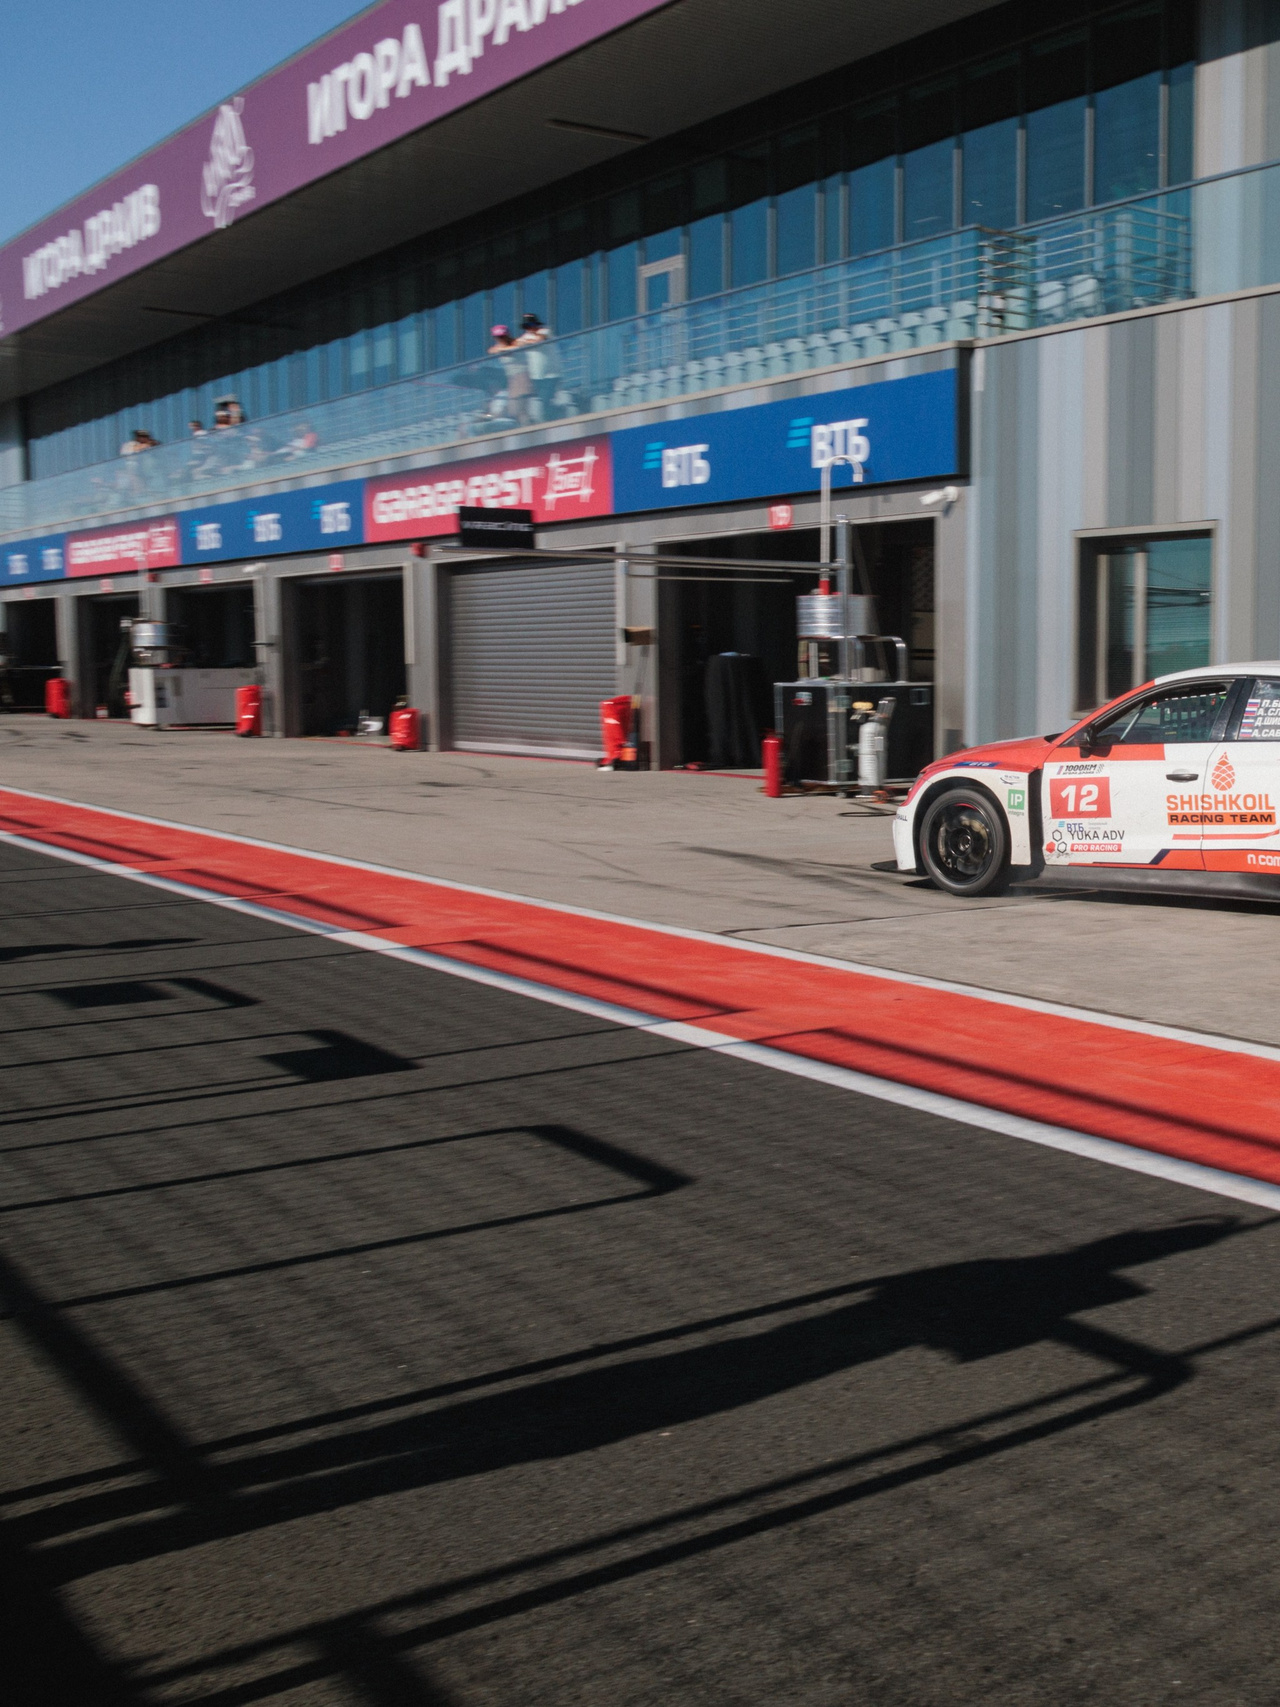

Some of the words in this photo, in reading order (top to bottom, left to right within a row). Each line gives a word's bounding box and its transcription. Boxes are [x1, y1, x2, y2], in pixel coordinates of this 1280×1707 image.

[307, 22, 431, 145] ИГОРА
[434, 0, 586, 87] ДРА
[811, 417, 870, 468] ВТБ
[661, 443, 711, 488] ВТБ
[1010, 793, 1023, 806] IP
[1060, 784, 1099, 812] 12
[1166, 793, 1276, 811] SHISHKOIL
[1170, 814, 1224, 823] RACING
[1230, 814, 1273, 823] TEAM
[1066, 823, 1085, 833] ВТБ
[1069, 830, 1100, 841] YUKA
[1102, 830, 1125, 841] ADV
